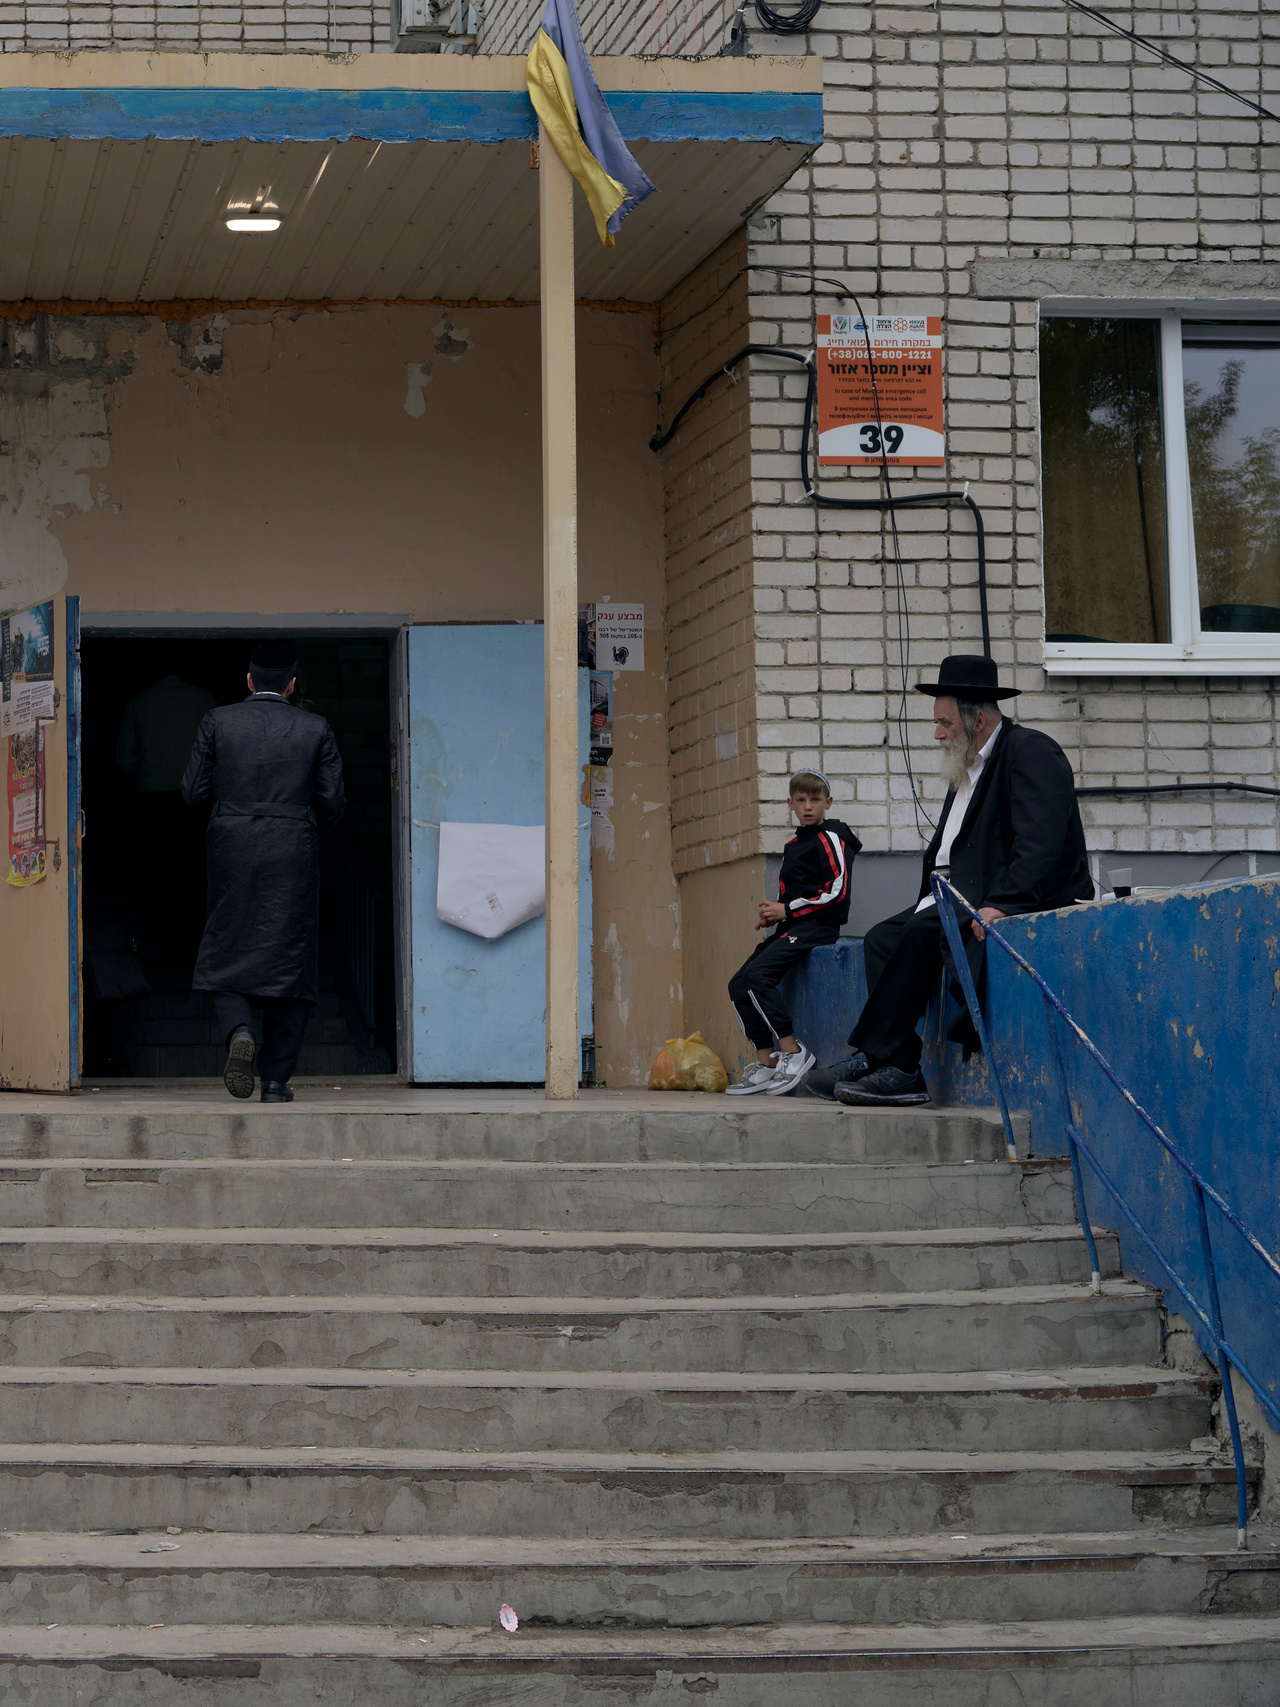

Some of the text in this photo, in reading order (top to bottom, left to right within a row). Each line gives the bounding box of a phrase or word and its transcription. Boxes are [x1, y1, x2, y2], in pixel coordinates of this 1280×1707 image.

[826, 338, 844, 347] חייג
[874, 339, 898, 347] חירום
[901, 339, 932, 348] במקרה
[827, 363, 858, 375] אזור
[902, 364, 932, 377] וציין
[859, 424, 904, 454] 39
[597, 612, 643, 622] מבצע ענק
